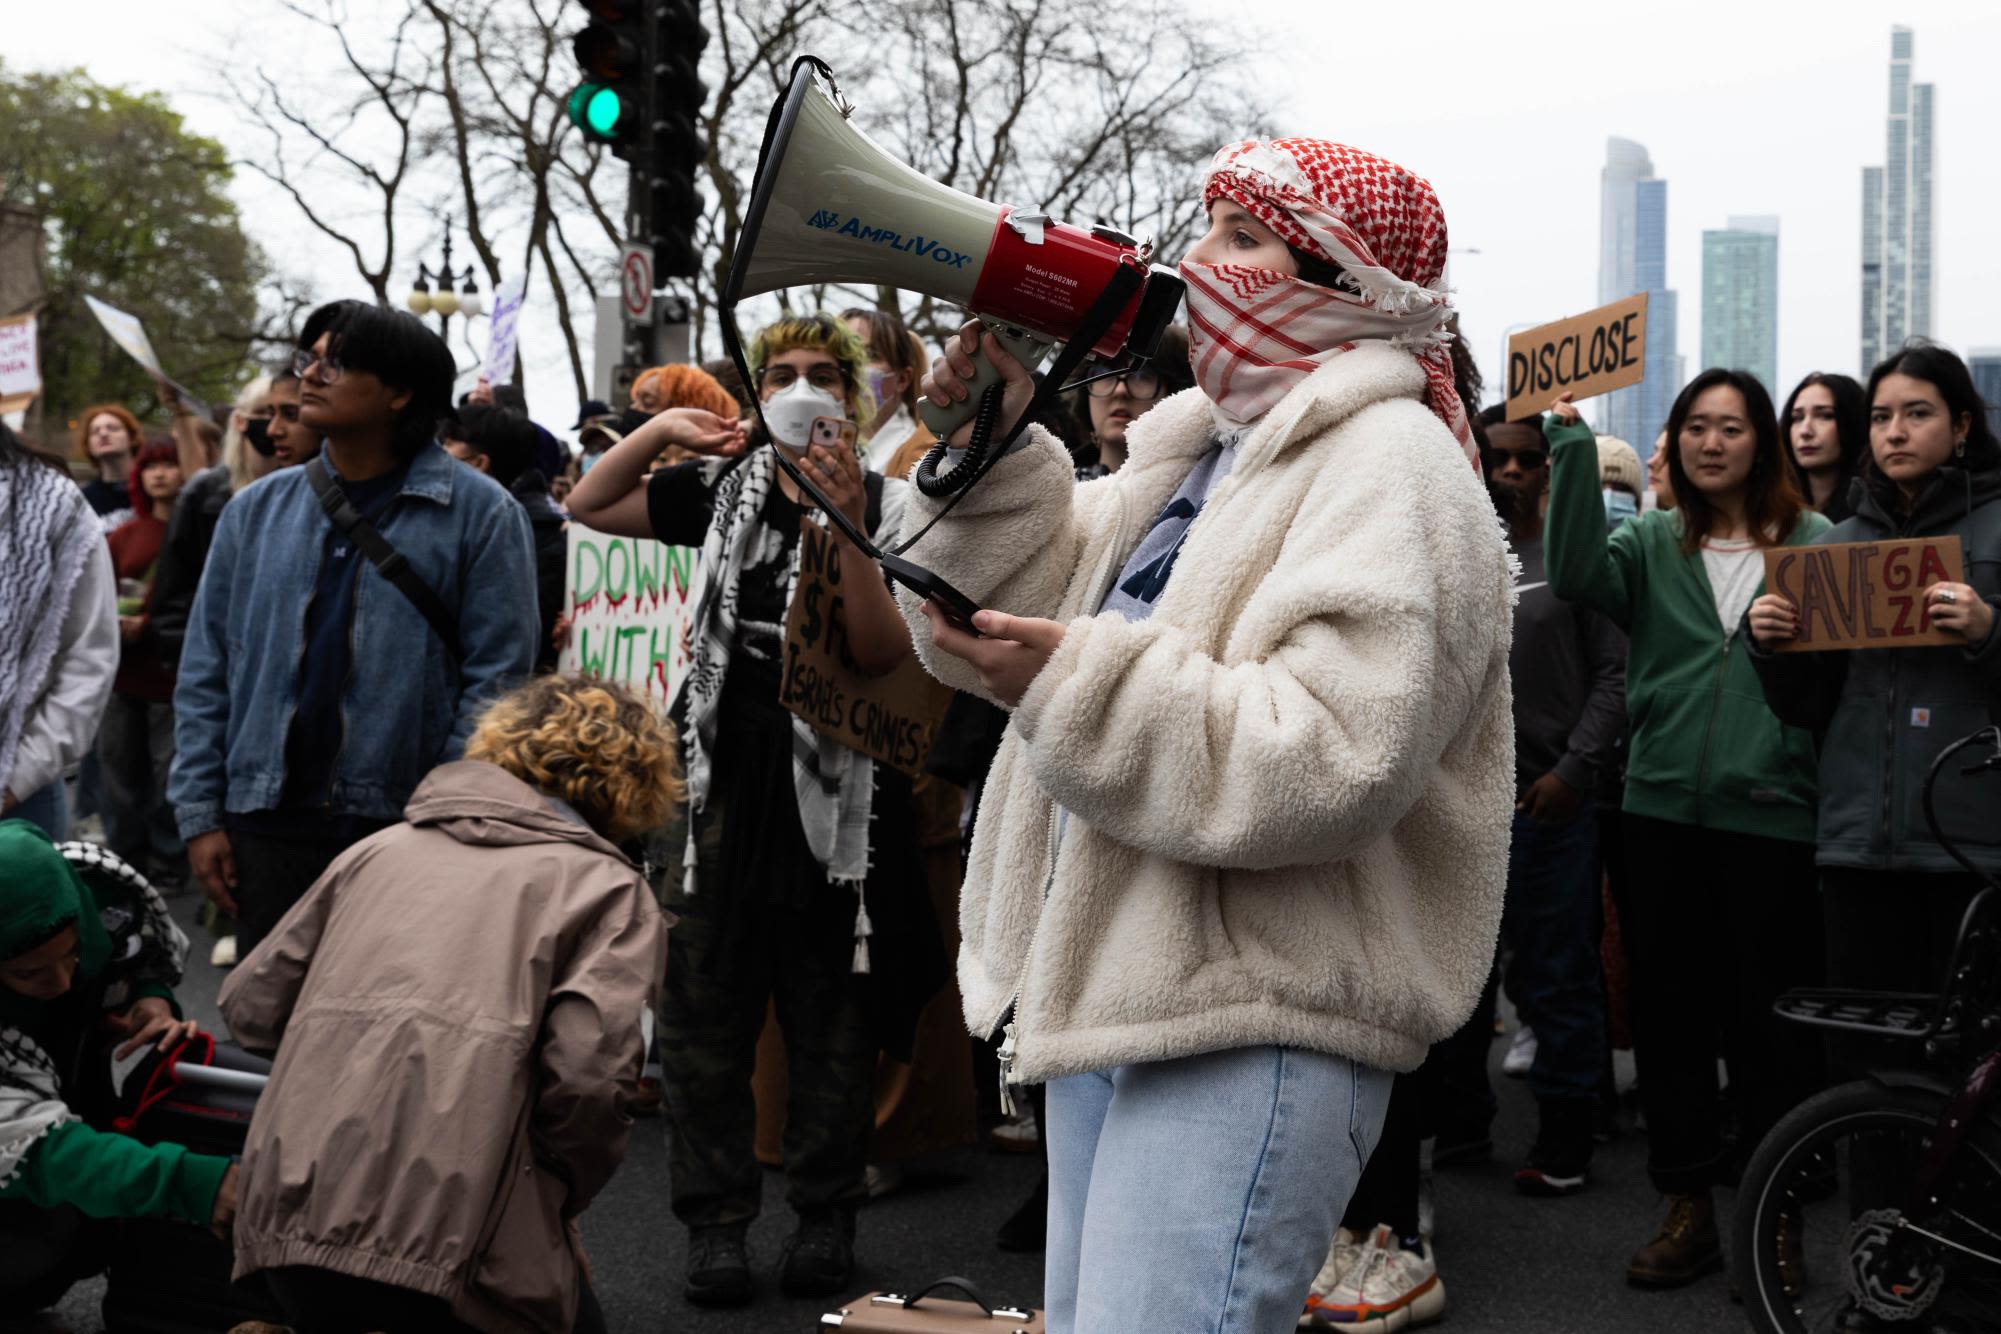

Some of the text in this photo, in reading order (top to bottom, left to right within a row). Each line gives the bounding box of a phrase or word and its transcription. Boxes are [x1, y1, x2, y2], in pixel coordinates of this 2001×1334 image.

[1025, 264, 1048, 278] Model
[1048, 272, 1078, 288] S602MR
[1510, 312, 1638, 400] DISCLOSE
[575, 537, 691, 608] DOWN
[805, 528, 841, 586] NO
[1775, 545, 1887, 643] SAVE
[581, 624, 672, 686] WITH
